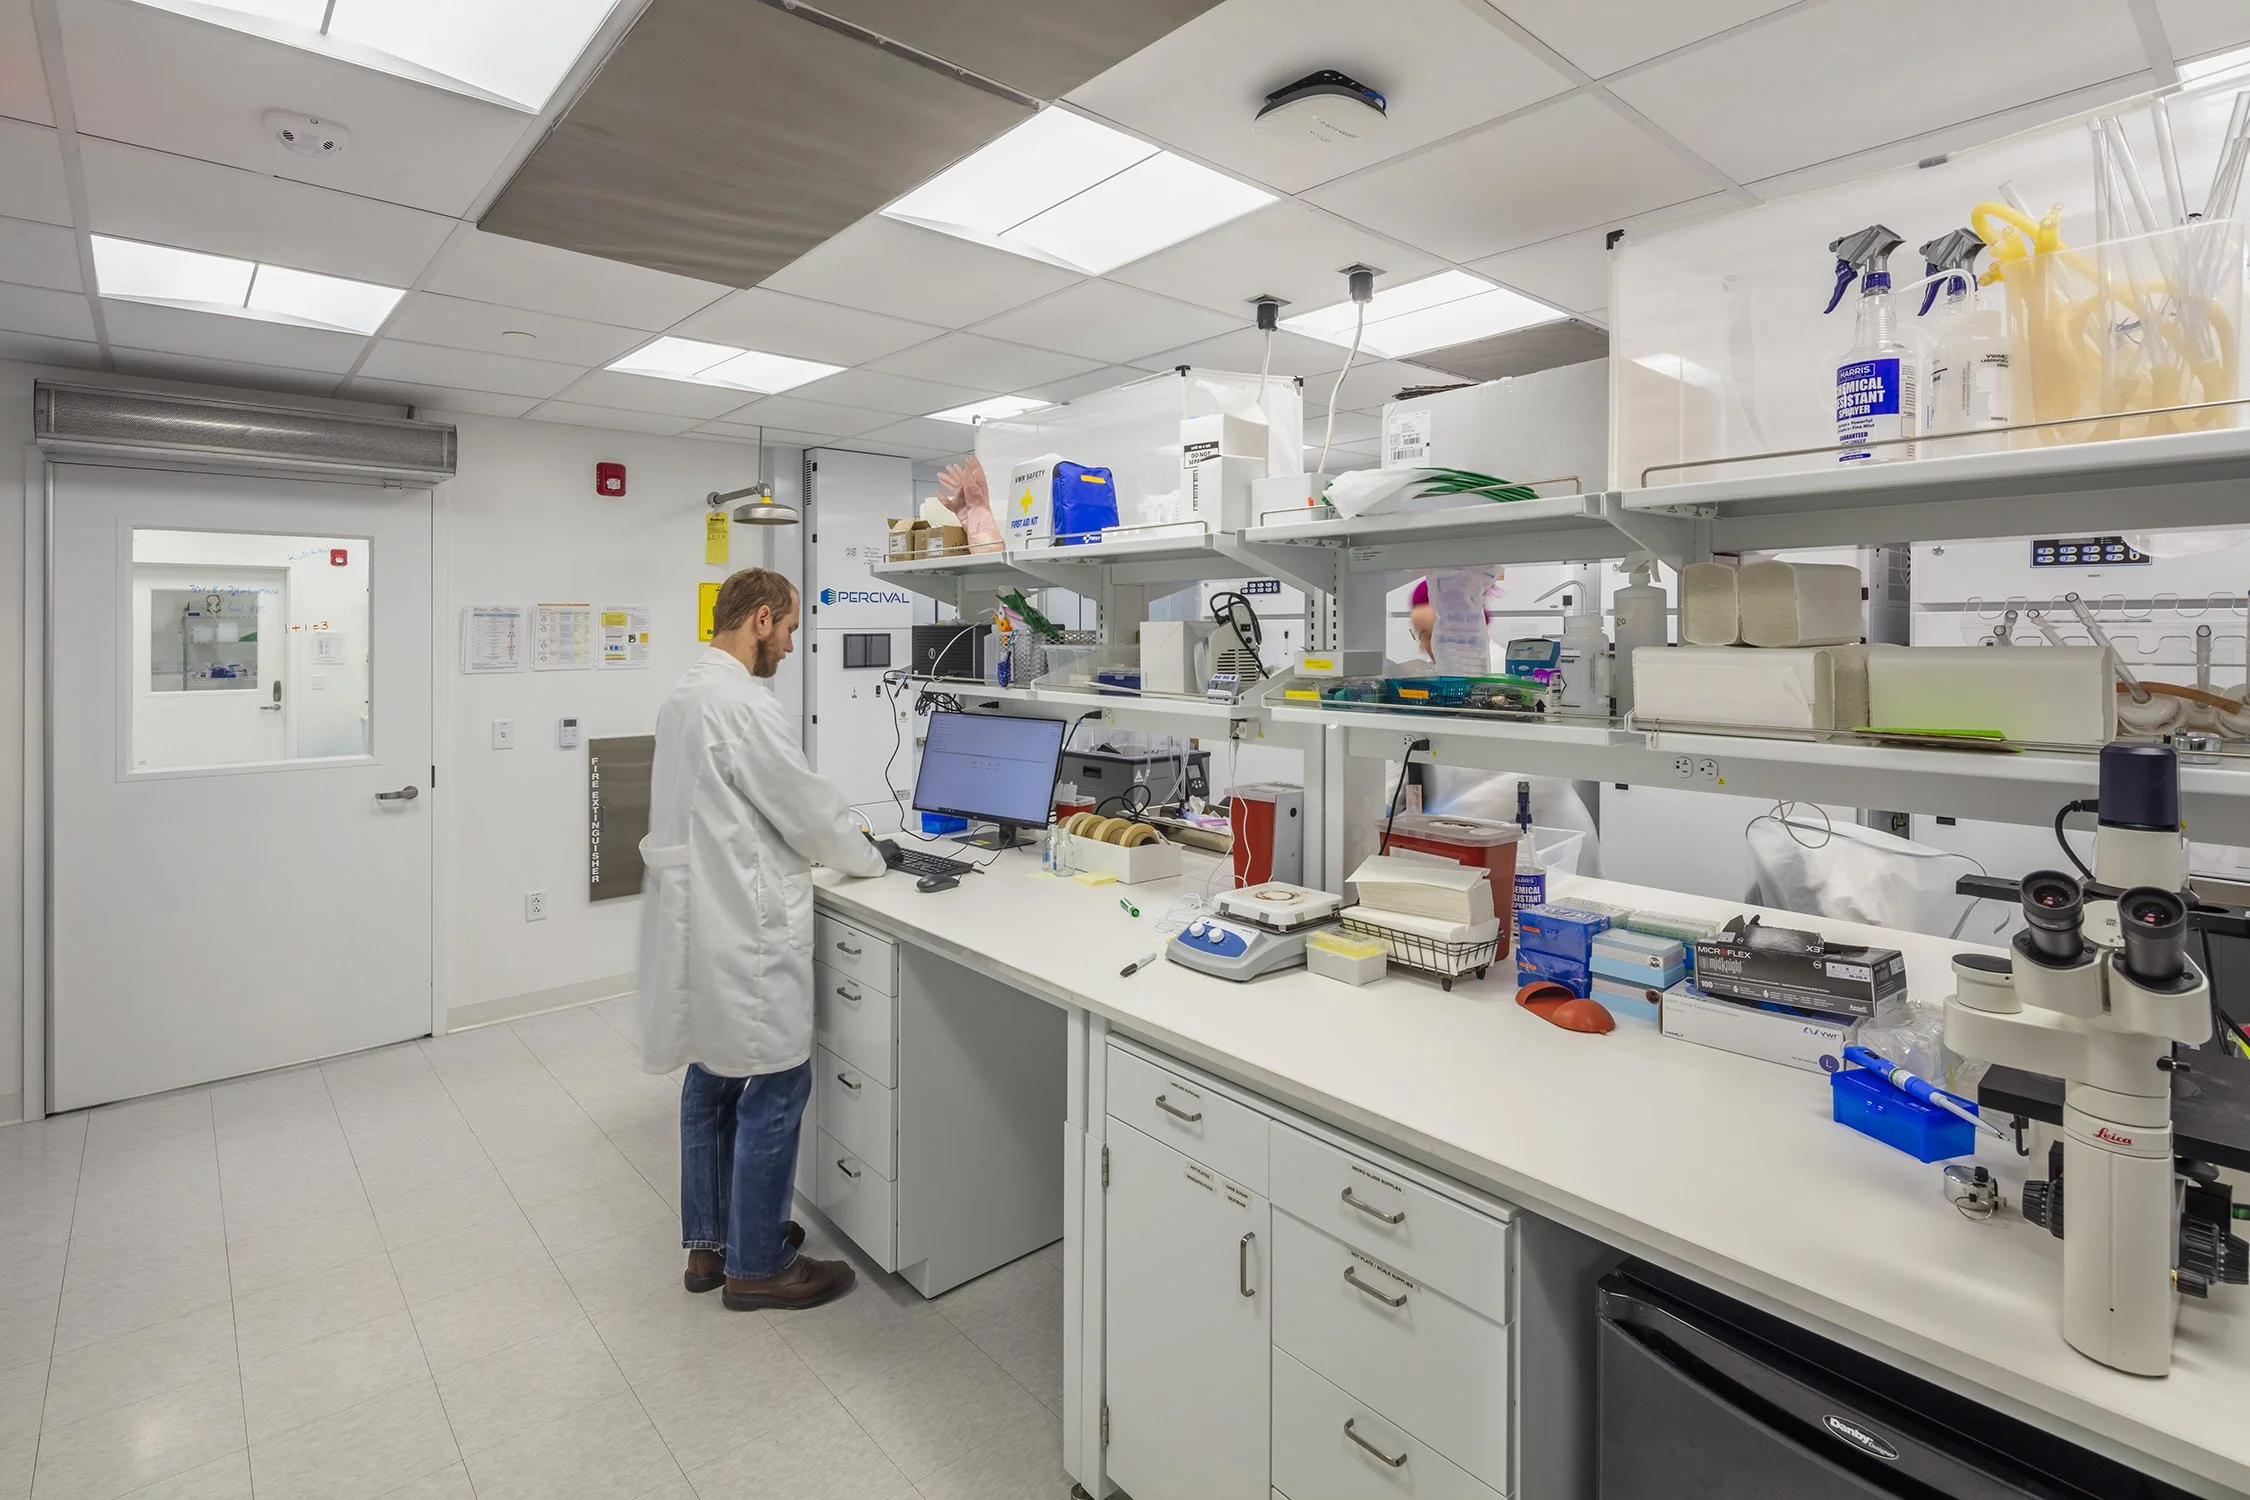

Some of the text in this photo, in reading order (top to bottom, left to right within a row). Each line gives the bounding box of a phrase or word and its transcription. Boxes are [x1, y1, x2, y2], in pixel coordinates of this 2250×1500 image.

[1841, 365, 1871, 379] HARRIS
[1838, 404, 1870, 419] SPRAYER
[1026, 470, 1045, 480] SAFETY
[1011, 519, 1022, 528] FIRST
[1022, 518, 1030, 526] AID
[846, 548, 857, 556] 28
[838, 592, 910, 604] PERCIVAL
[1516, 886, 1540, 894] EMICAL
[1698, 946, 1752, 958] MICROFLEX
[1701, 980, 1713, 988] 100
[1850, 1004, 1868, 1012] Ansell
[1826, 1060, 1832, 1068] L
[2093, 1128, 2133, 1146] Leica
[1352, 1166, 1402, 1192] MICRO GLASS SUPPLIES
[1360, 1256, 1374, 1267] PLATE
[1377, 1265, 1391, 1276] SCALE
[1392, 1273, 1414, 1288] SUPPLIES
[1830, 1417, 1873, 1444] Danby
